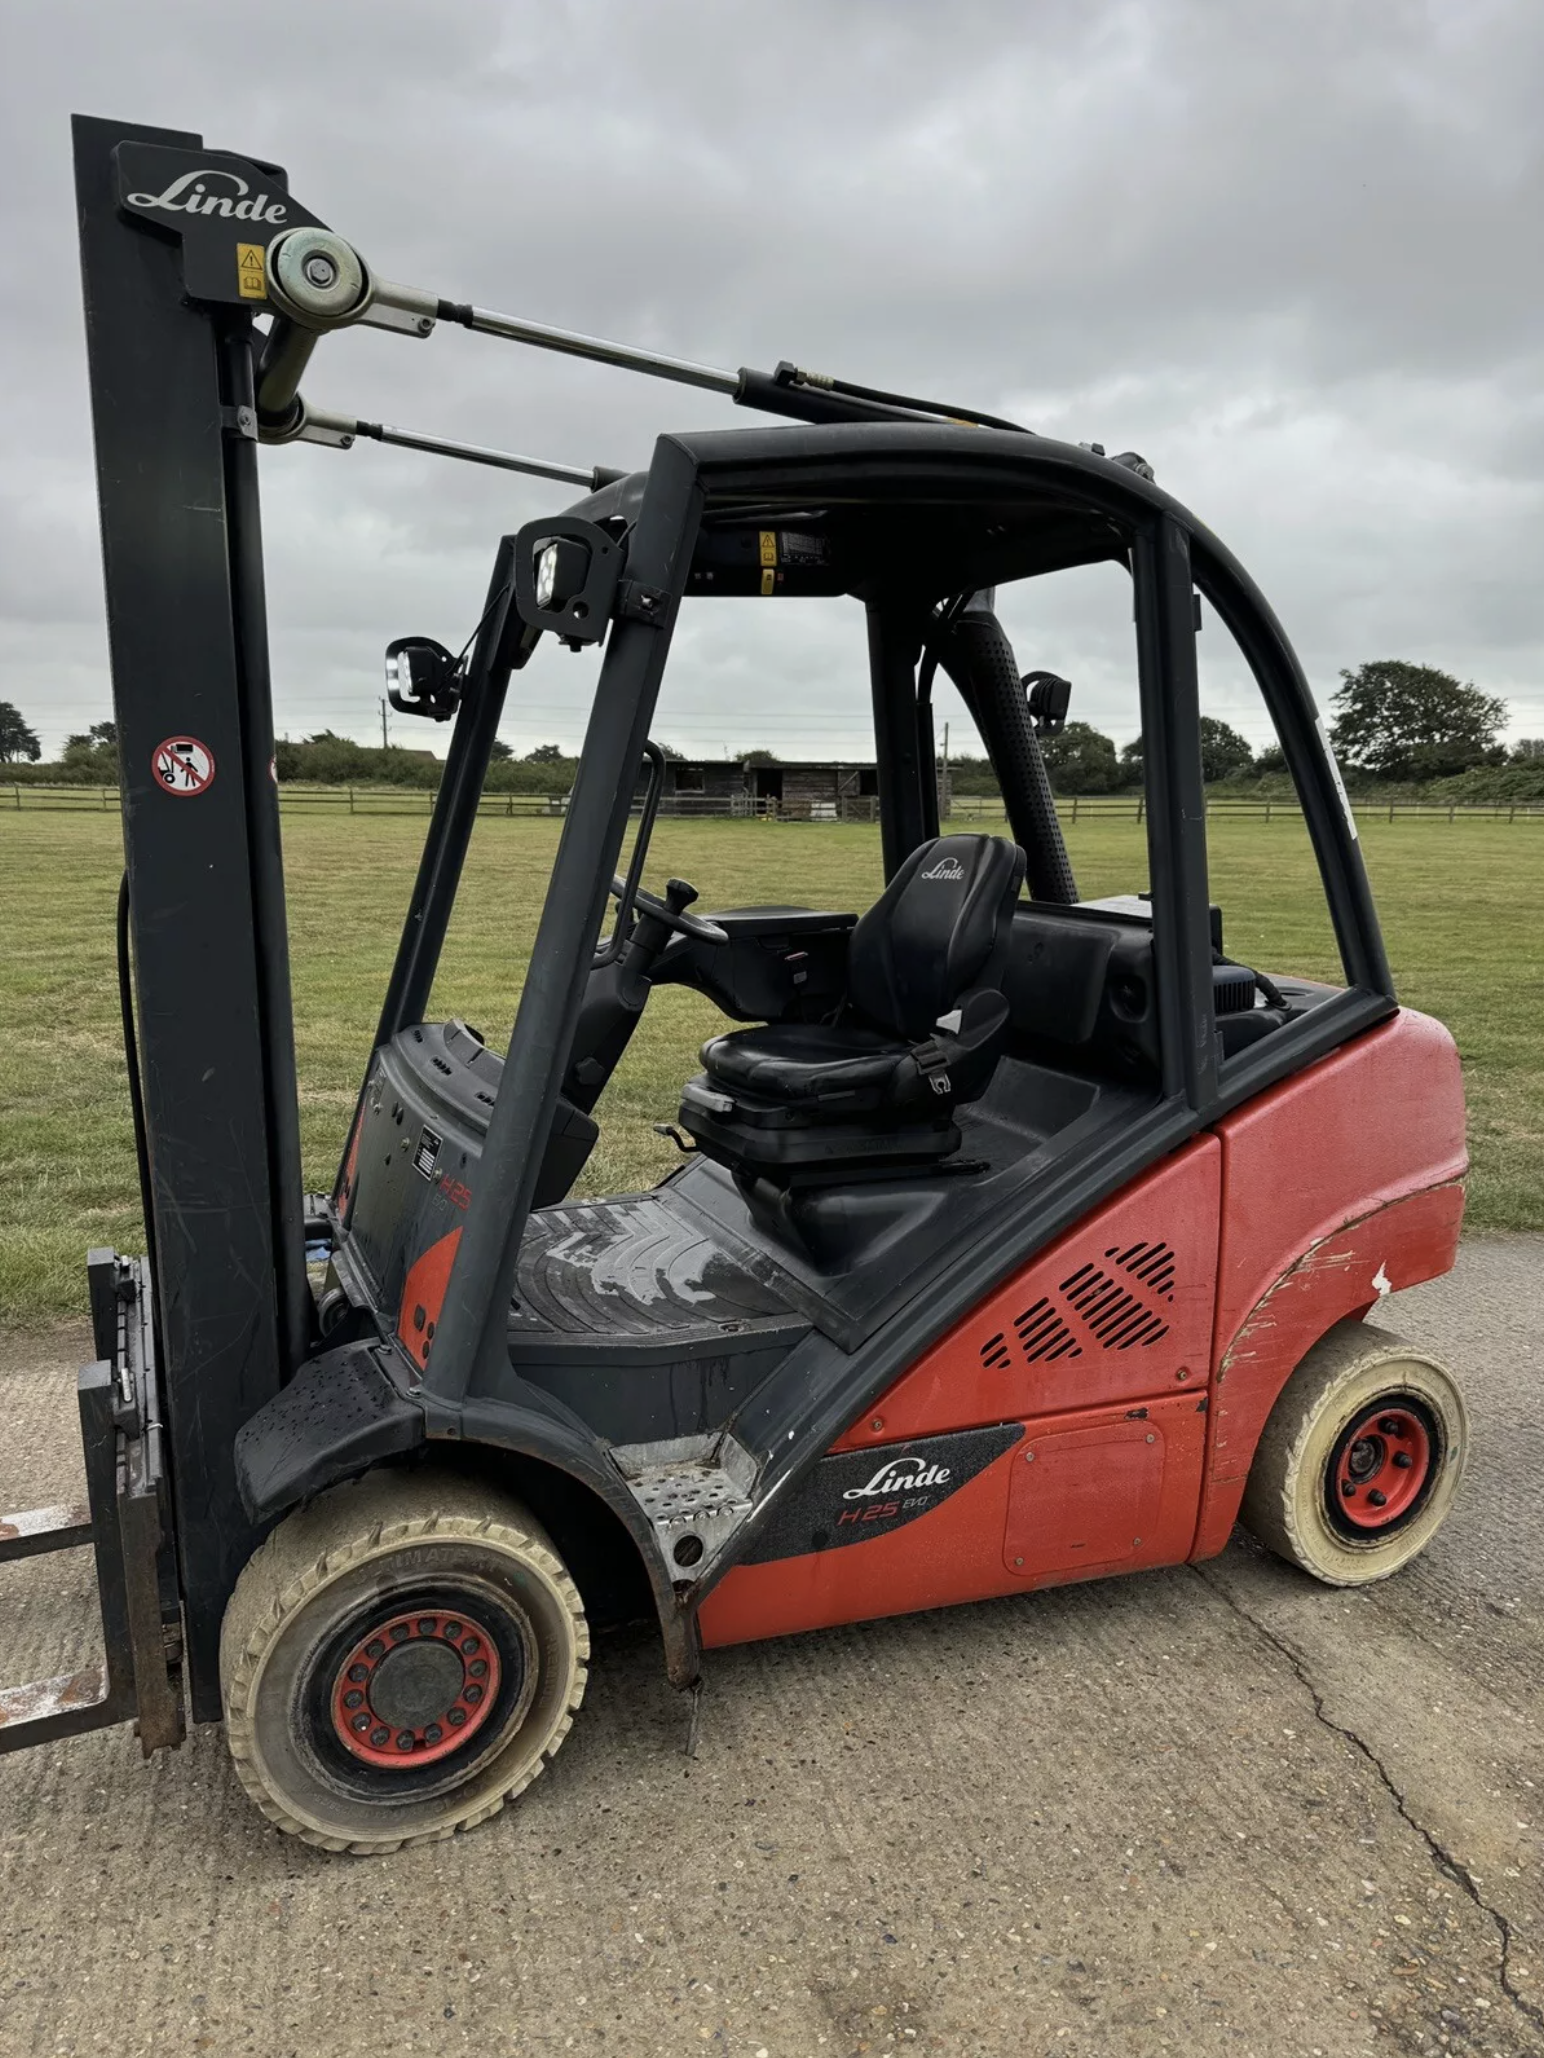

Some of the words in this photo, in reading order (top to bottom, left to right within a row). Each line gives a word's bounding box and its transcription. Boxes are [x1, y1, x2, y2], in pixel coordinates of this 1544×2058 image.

[127, 169, 287, 224] Linde
[921, 857, 966, 880] Linde
[843, 1457, 950, 1500] Linde
[902, 1496, 929, 1509] EVO
